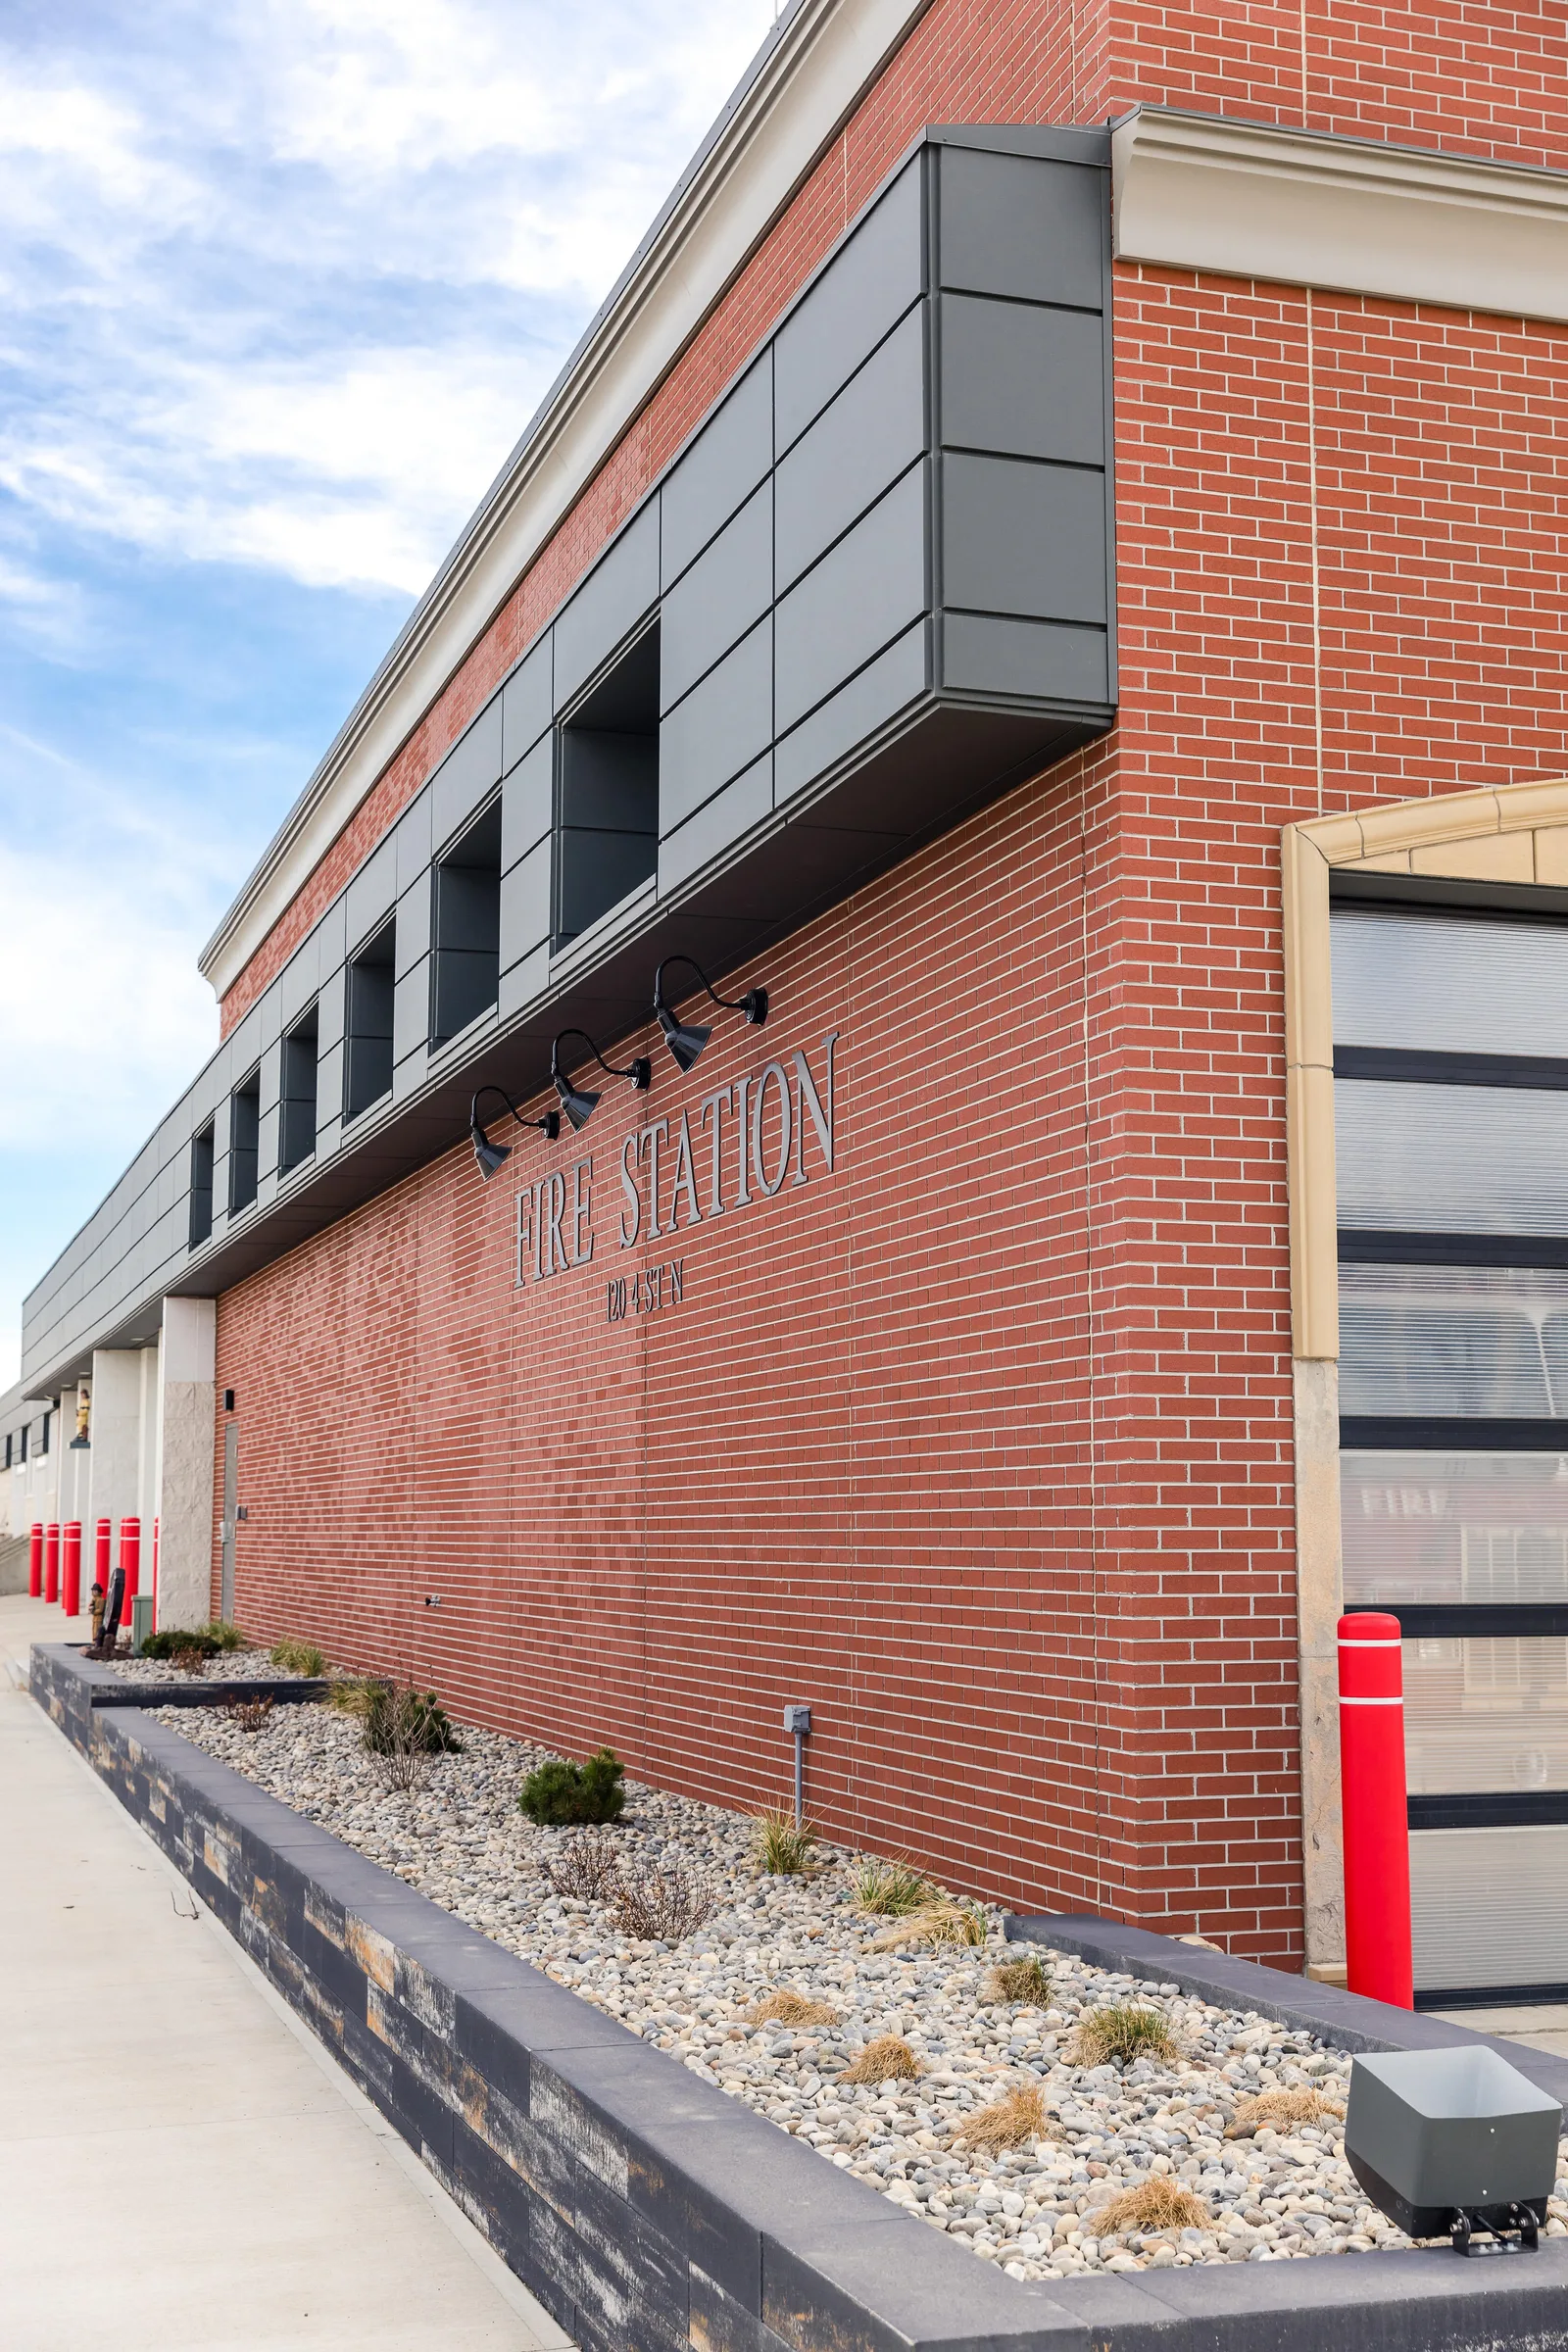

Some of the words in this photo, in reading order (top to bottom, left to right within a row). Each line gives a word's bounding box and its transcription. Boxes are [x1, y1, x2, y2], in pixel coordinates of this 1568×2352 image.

[514, 1155, 594, 1289] FIRE
[619, 1031, 840, 1250] STATION
[607, 1277, 626, 1323] 120
[630, 1272, 640, 1314] 4
[644, 1264, 664, 1313] ST
[669, 1257, 684, 1305] N
